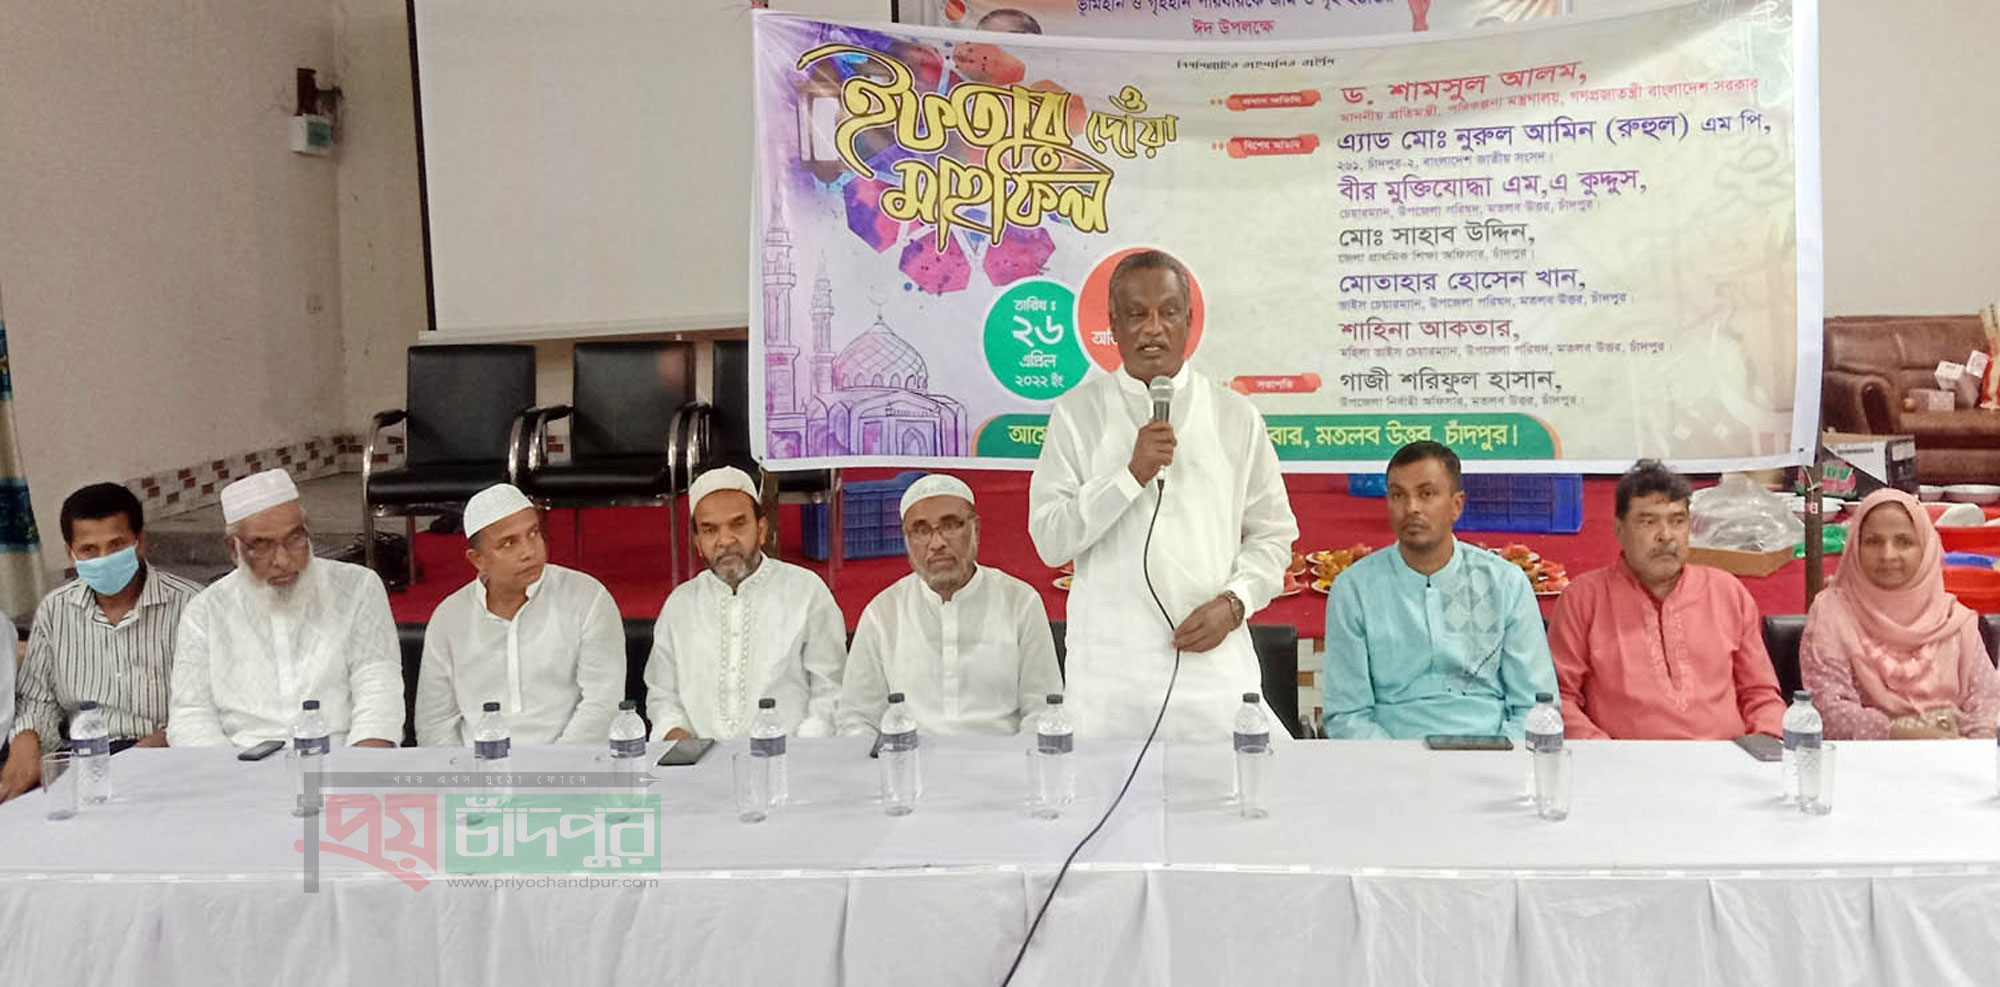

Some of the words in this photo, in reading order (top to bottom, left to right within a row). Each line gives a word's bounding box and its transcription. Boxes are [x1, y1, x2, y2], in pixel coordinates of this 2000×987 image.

[1218, 18, 1275, 35] উপলক্ষে
[1341, 86, 1374, 106] ড.
[1389, 75, 1490, 103] শামসুল
[1500, 60, 1588, 88] আলম,
[797, 43, 1074, 178] ইফতার
[1338, 133, 1392, 152] এ্যাড
[1402, 129, 1447, 150] মোঃ
[1455, 126, 1515, 152] নুরুল
[1524, 115, 1597, 144] আমিন
[1606, 111, 1690, 146] (রুহুল)
[1700, 115, 1733, 132] এম
[1740, 109, 1772, 136] পি,
[882, 140, 1114, 252] মাহফিল
[1338, 175, 1377, 201] বীর
[1385, 174, 1494, 205] মুক্তিযোদ্ধা
[1577, 169, 1647, 197] কুদ্দুস,
[1339, 227, 1384, 248] মোঃ
[1391, 225, 1457, 247] সাহাব
[1463, 218, 1536, 246] উদ্দিন,
[1340, 272, 1439, 294] মোতাহার
[1447, 270, 1528, 293] হোসেন
[1536, 267, 1586, 290] খান,
[1012, 314, 1065, 348] ২৬
[1339, 316, 1412, 342] শাহিনা
[1419, 317, 1520, 341] আকতার,
[1019, 349, 1057, 369] এপ্রিল
[1015, 374, 1049, 388] ২০২২
[1341, 366, 1391, 392] গাজী
[1400, 366, 1480, 395] শরিফুল
[1487, 370, 1562, 393] হাসান,
[1315, 425, 1381, 446] মতলব
